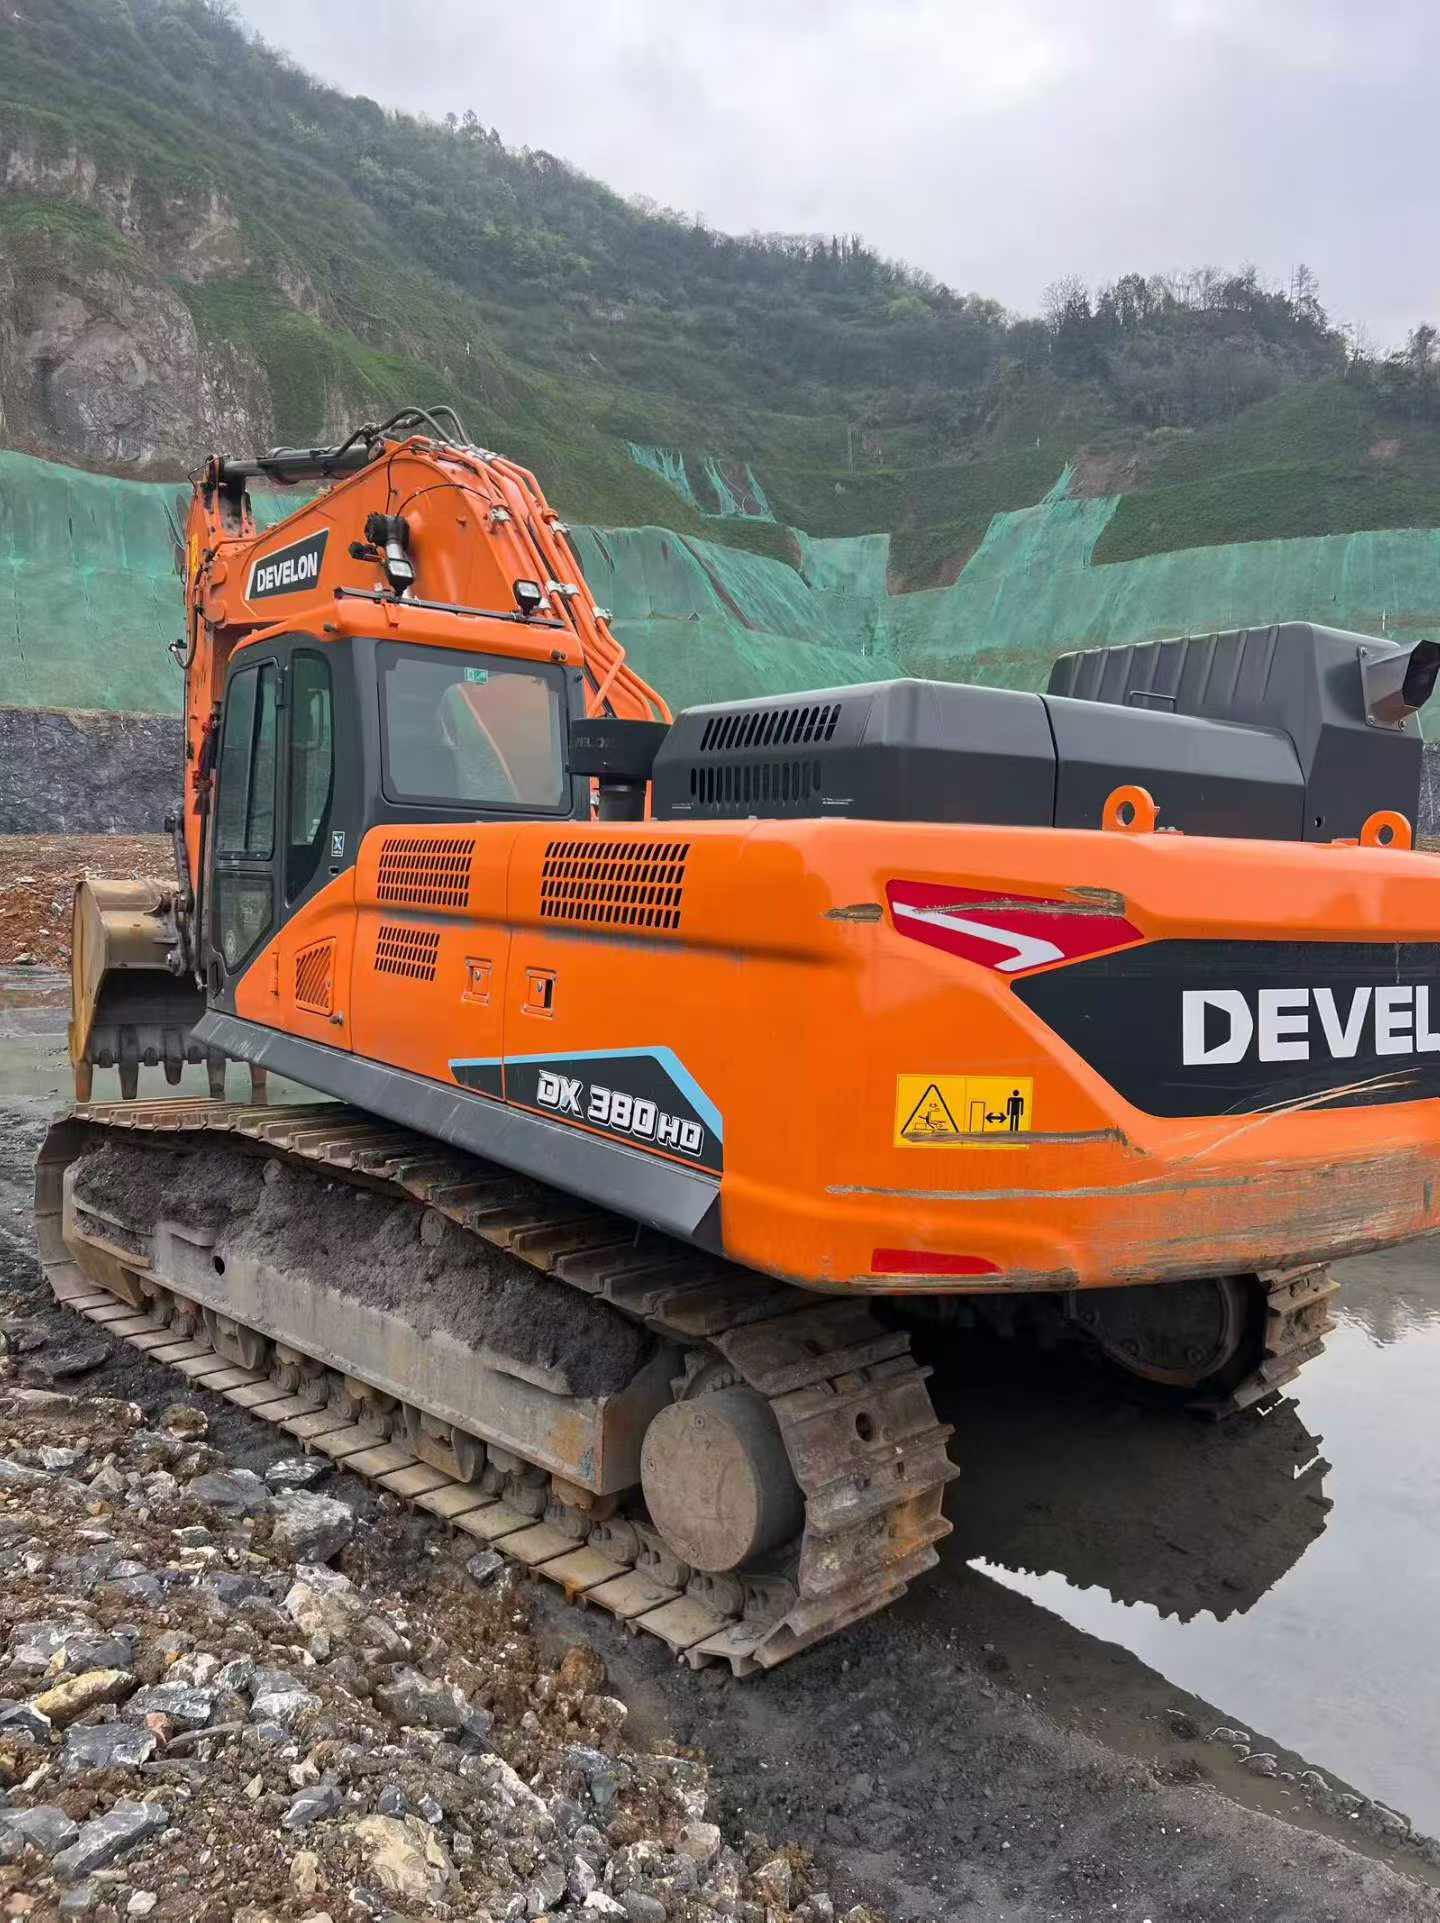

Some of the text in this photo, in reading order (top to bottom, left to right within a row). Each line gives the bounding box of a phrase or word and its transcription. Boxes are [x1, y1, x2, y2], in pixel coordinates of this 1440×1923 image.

[256, 551, 318, 592] DEVELON
[1182, 985, 1440, 1066] DEVEL
[537, 1070, 584, 1118] DX
